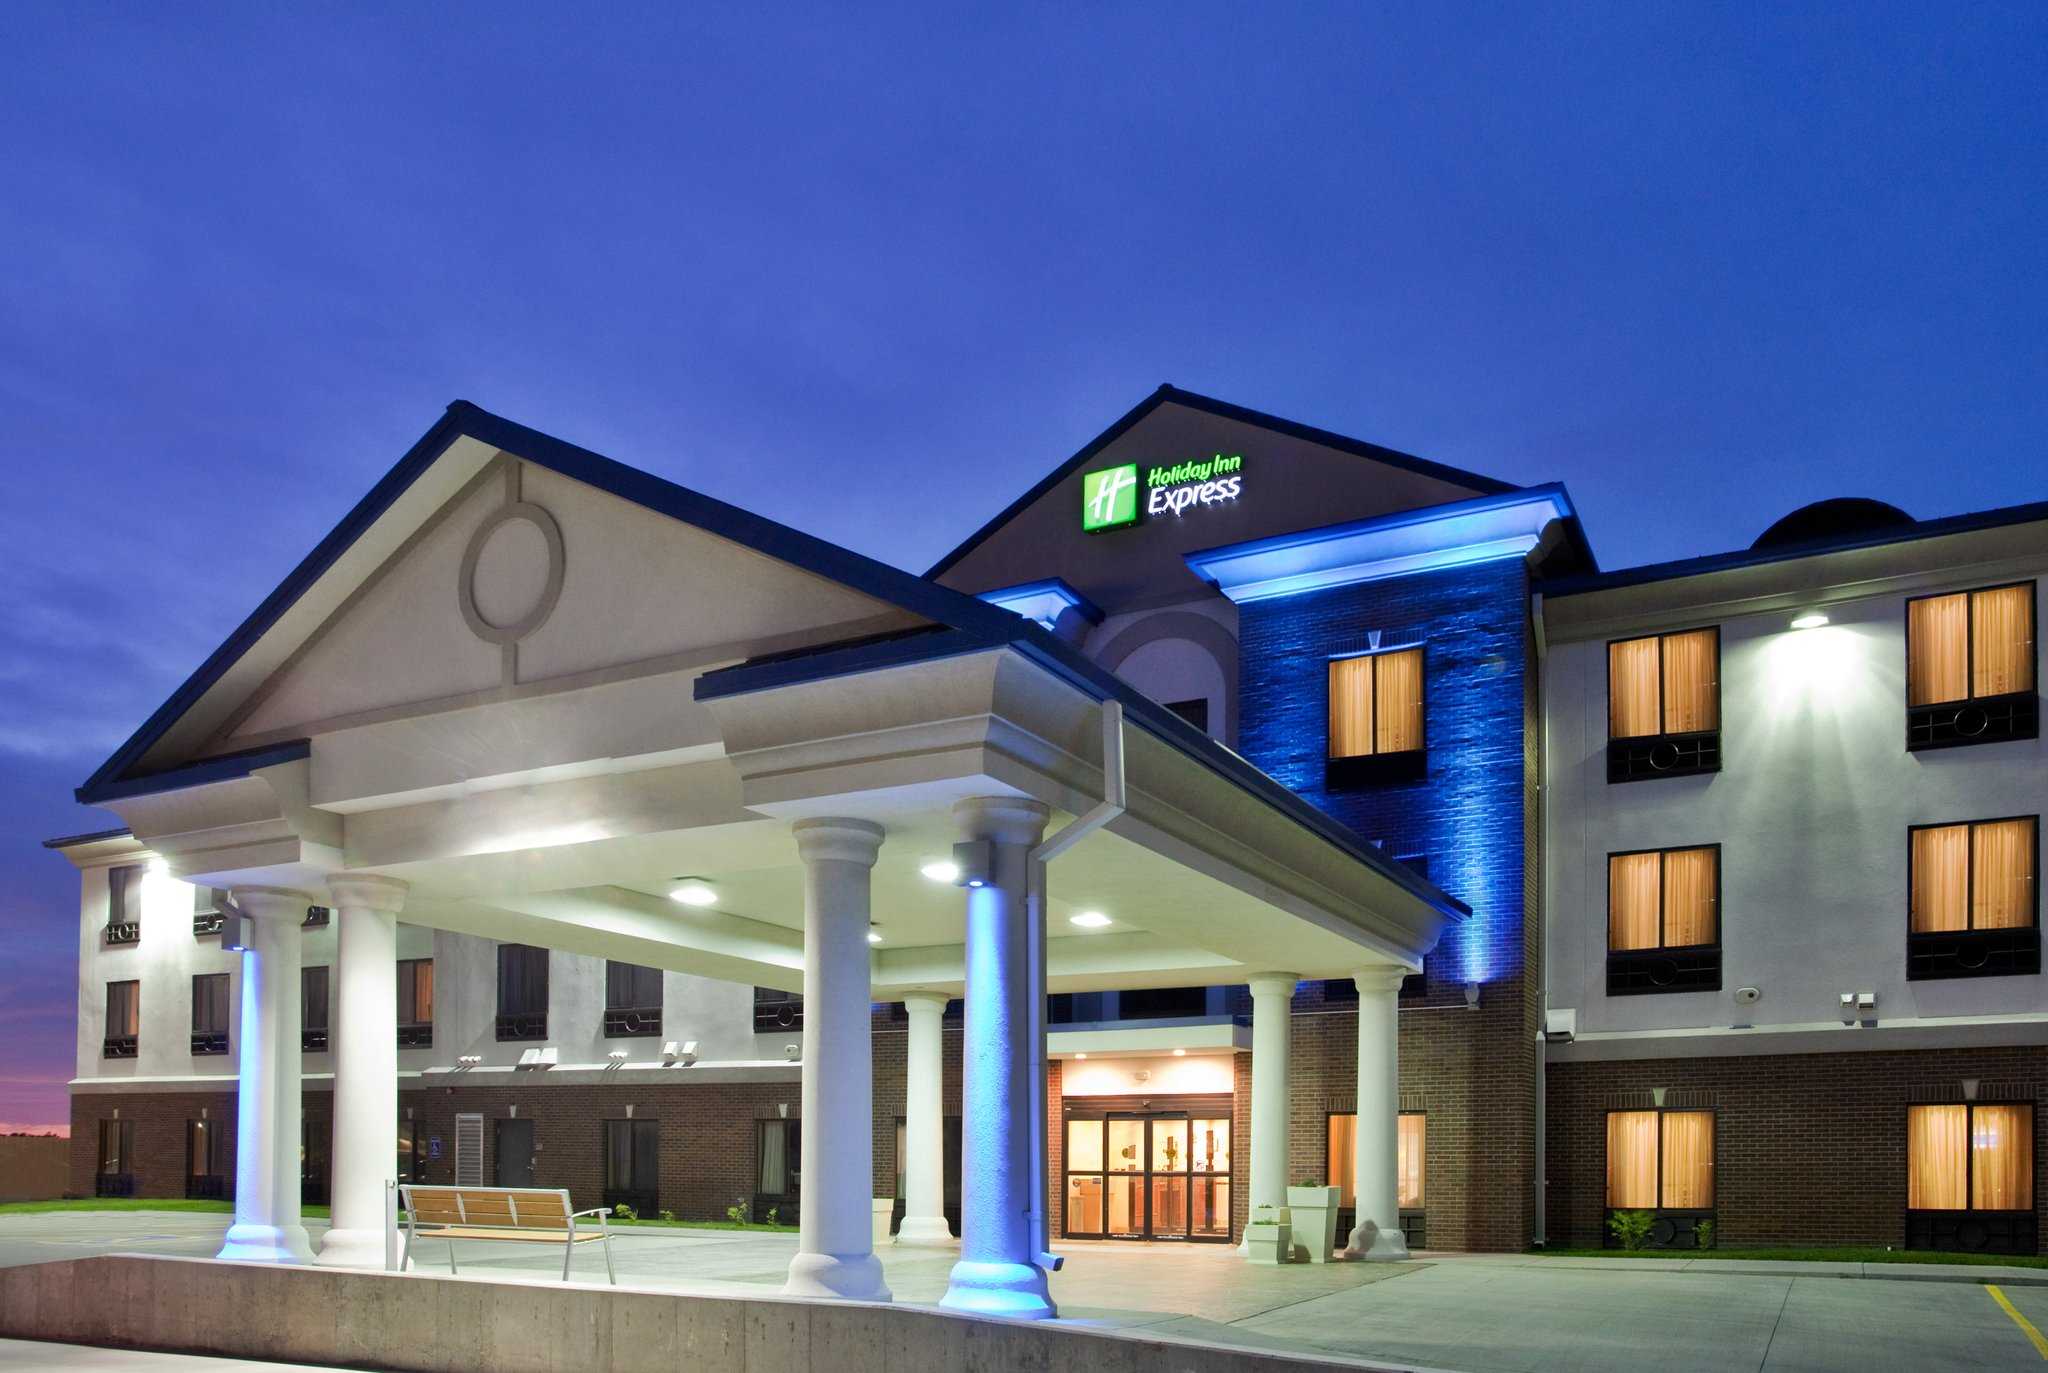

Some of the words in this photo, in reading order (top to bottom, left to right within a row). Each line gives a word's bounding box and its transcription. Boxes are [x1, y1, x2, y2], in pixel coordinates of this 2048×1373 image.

[1148, 461, 1211, 486] Holiday
[1214, 454, 1241, 473] Inn
[1148, 476, 1241, 514] Express
